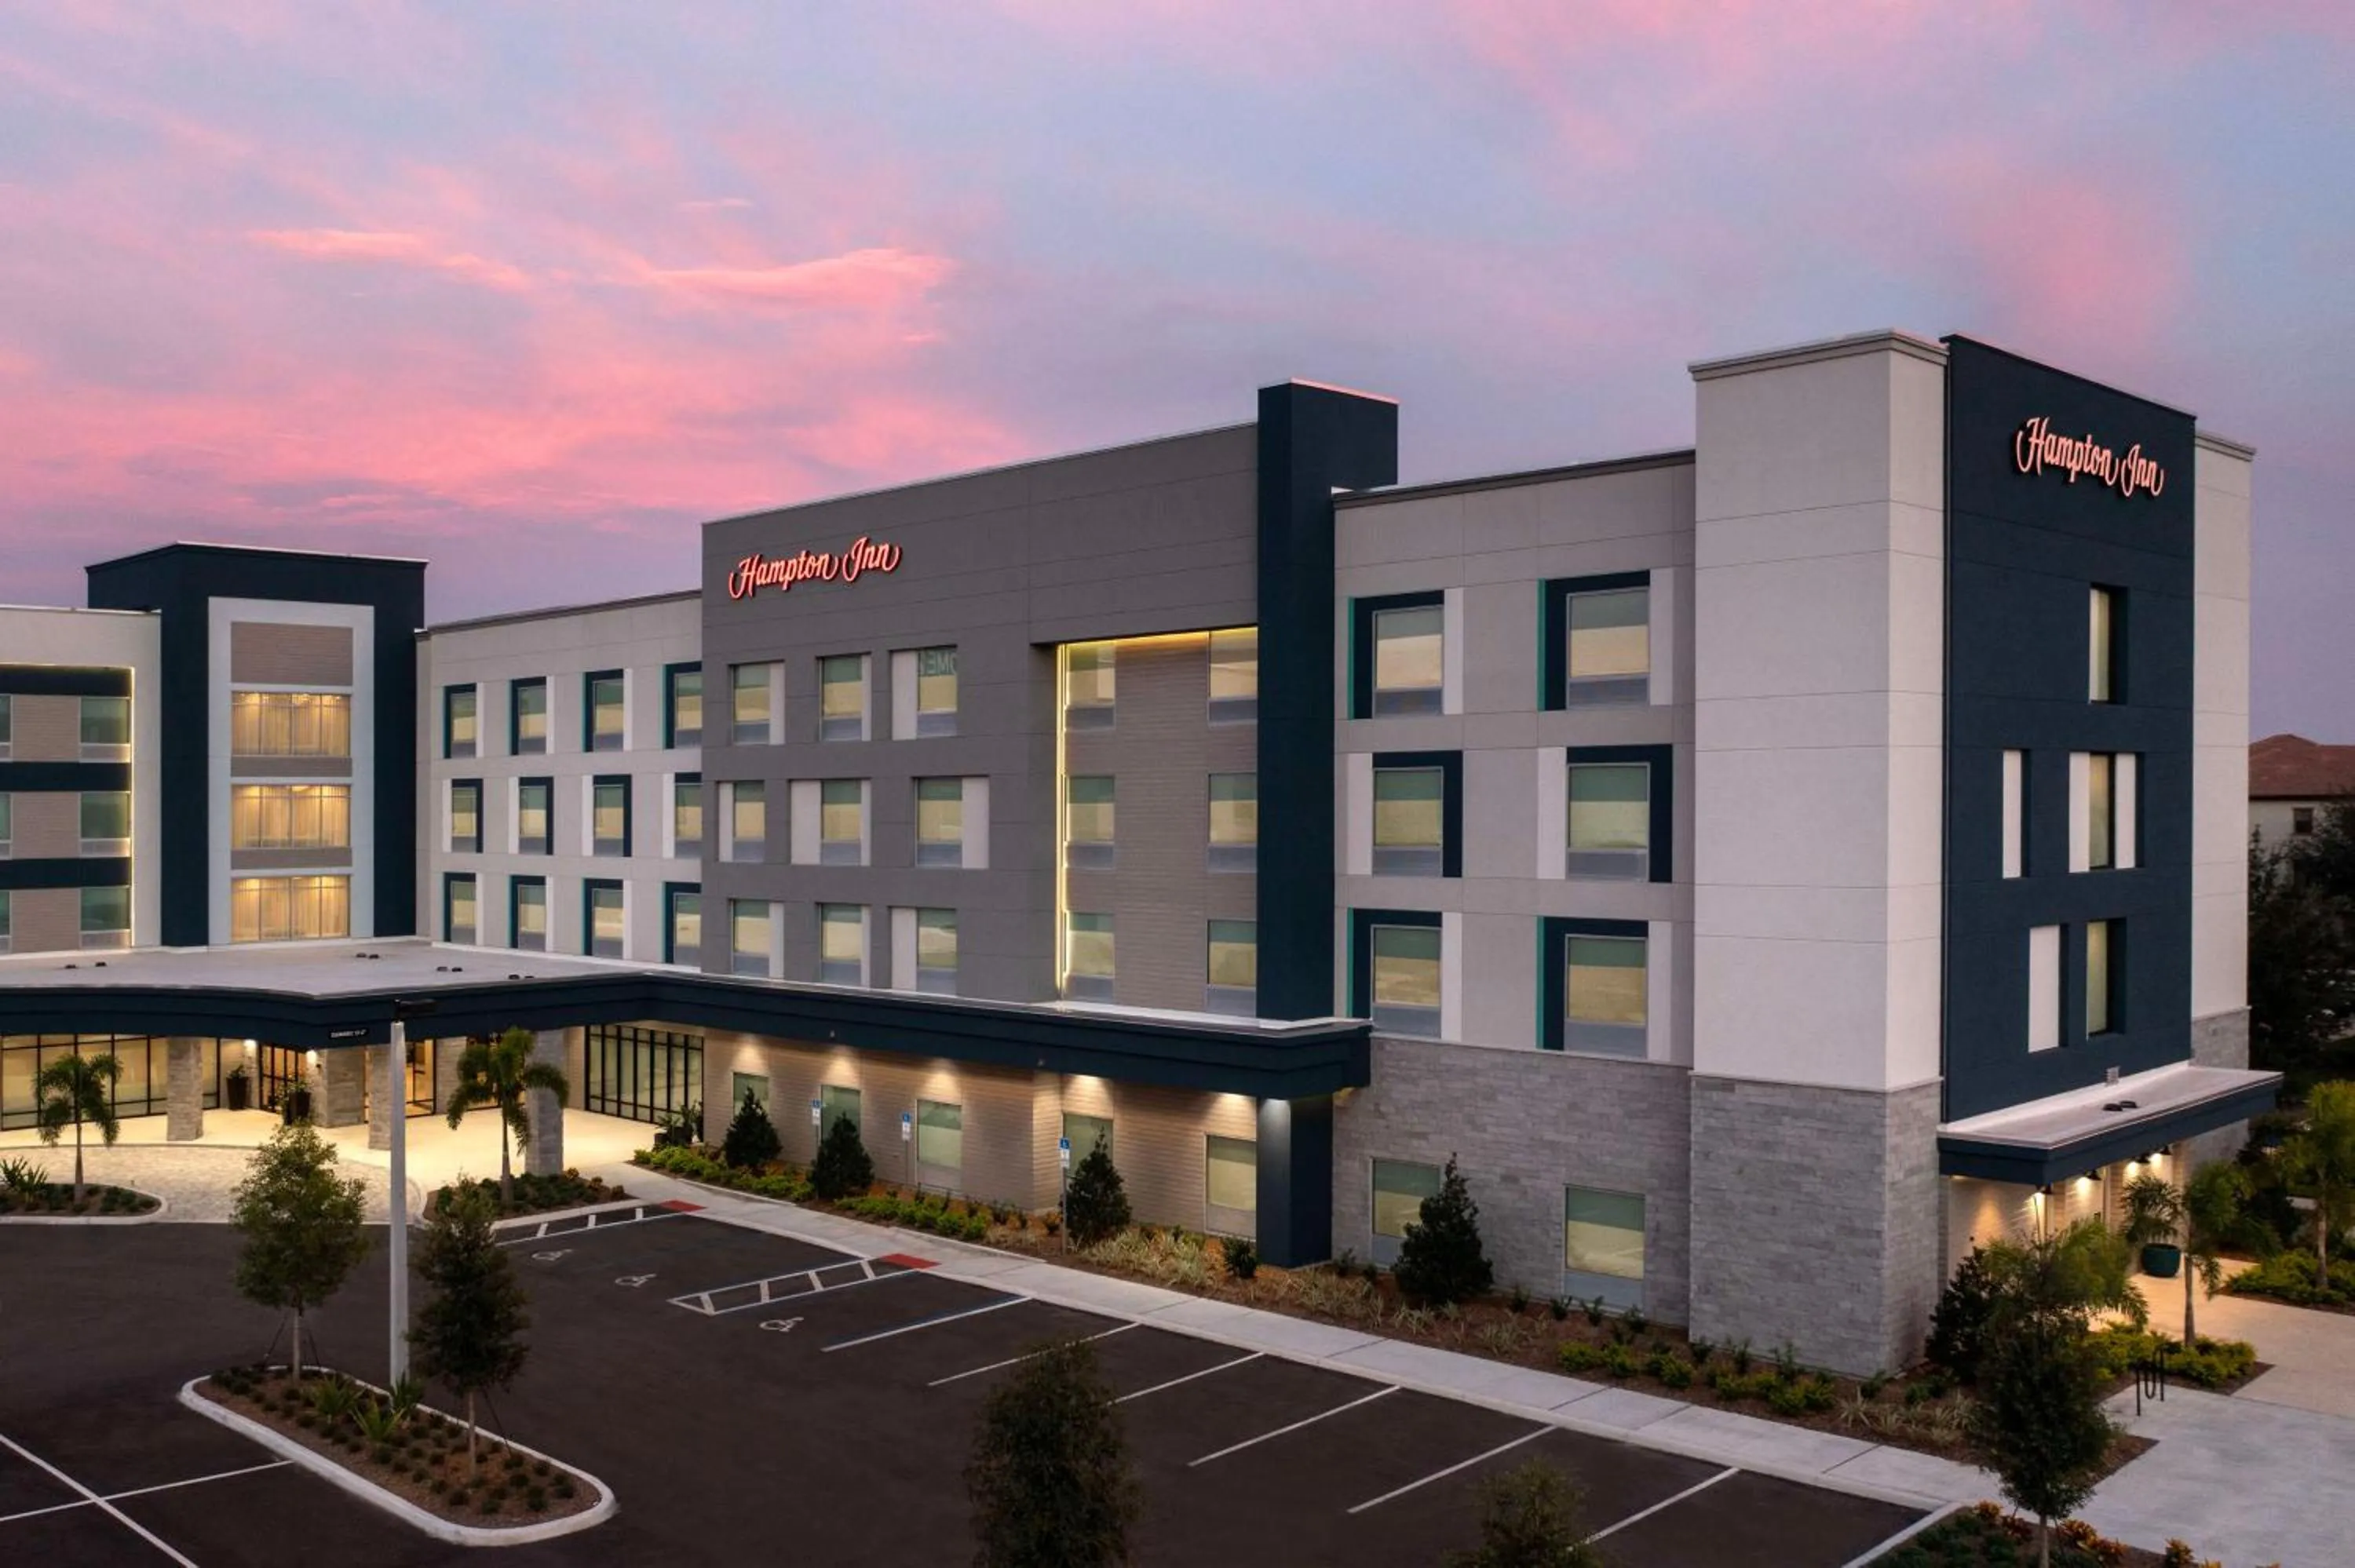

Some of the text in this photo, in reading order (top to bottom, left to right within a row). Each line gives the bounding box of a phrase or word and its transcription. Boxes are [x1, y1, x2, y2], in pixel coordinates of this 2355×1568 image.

[2015, 415, 2164, 498] Hampton Inn
[728, 536, 901, 599] Hampton Inn
